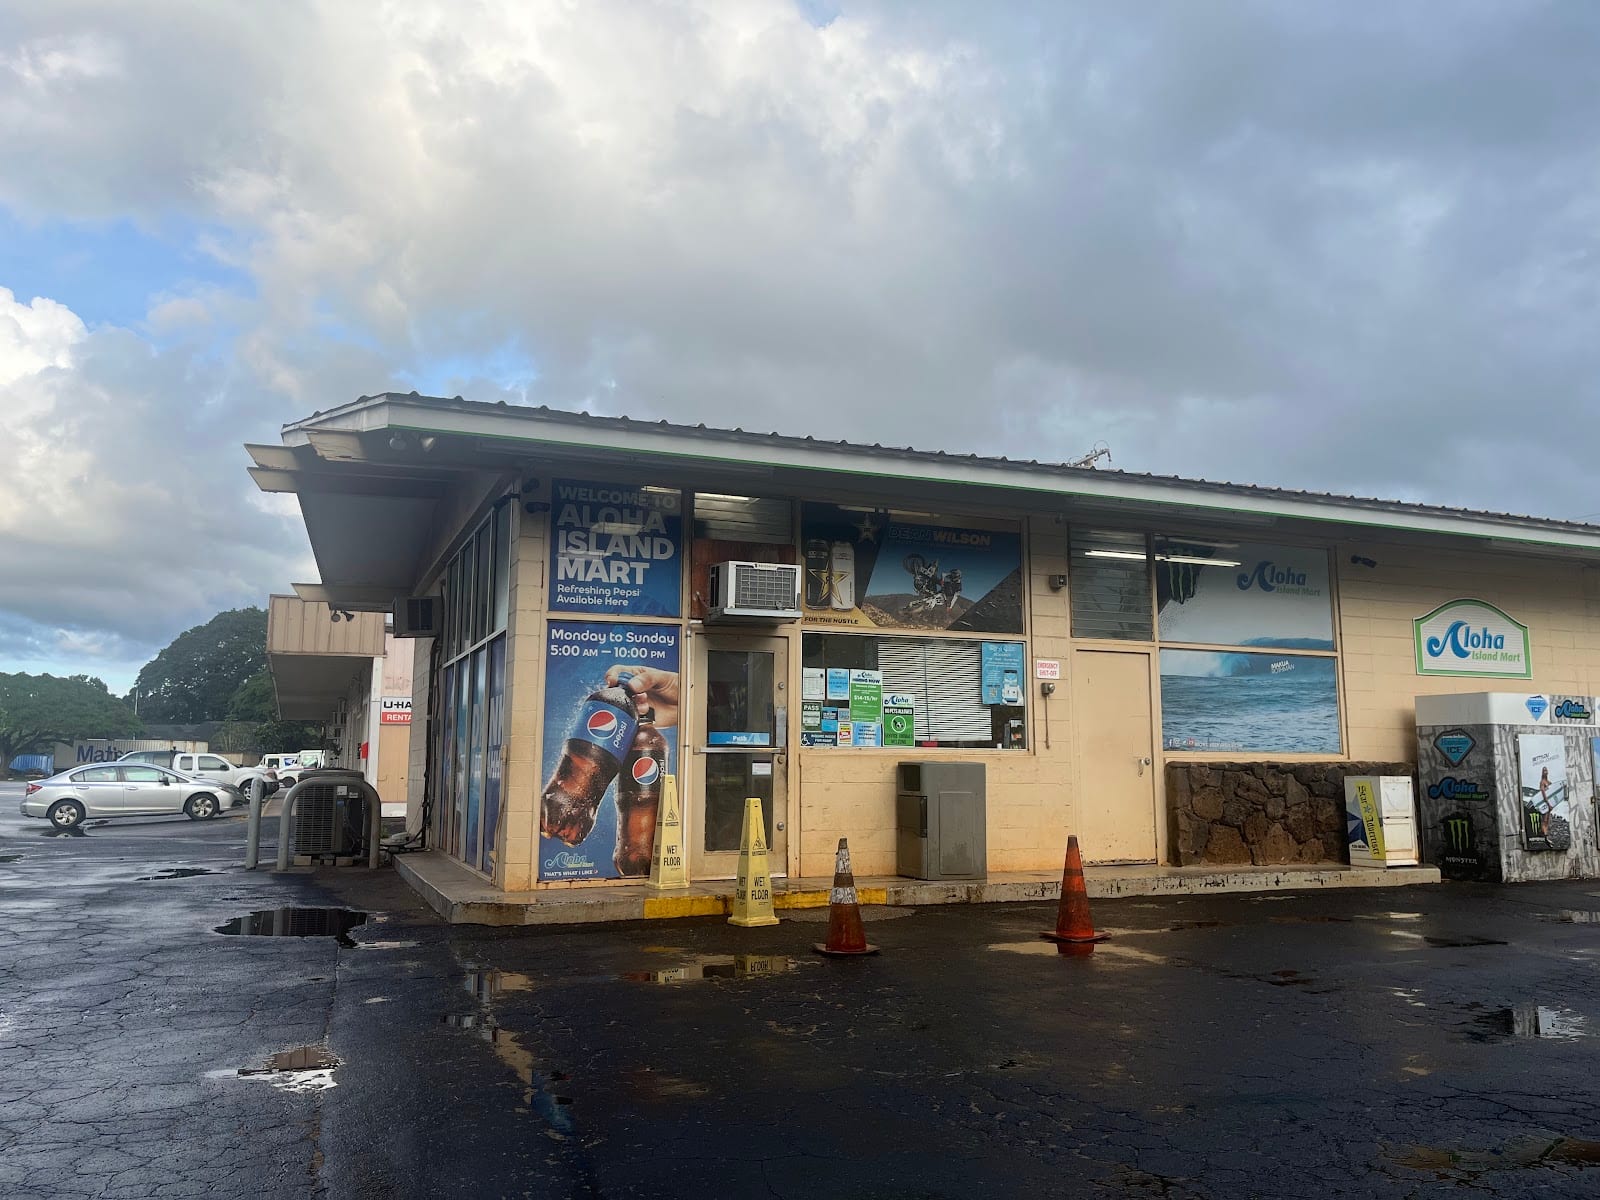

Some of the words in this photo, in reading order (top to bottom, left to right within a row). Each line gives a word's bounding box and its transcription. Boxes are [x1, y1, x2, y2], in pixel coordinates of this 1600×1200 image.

[559, 486, 648, 506] WELCOME
[652, 494, 676, 509] TO
[557, 503, 667, 534] ALOHA
[558, 529, 675, 560] ISLAND
[933, 530, 991, 546] WILSON
[557, 557, 650, 585] MART
[1236, 560, 1307, 592] Aloha
[557, 584, 611, 597] Refreshing
[613, 587, 641, 598] Pepsi
[556, 595, 603, 605] Available
[605, 597, 629, 606] Here
[551, 629, 606, 644] Monday
[609, 632, 623, 642] to
[626, 632, 675, 646] Sunday
[1426, 620, 1505, 659] Aloha
[550, 645, 580, 656] 5:00
[582, 649, 598, 657] AM
[614, 646, 648, 658] 10:00
[1472, 651, 1498, 661] Island
[1500, 653, 1521, 662] Mart
[613, 721, 628, 749] pepsi
[1446, 746, 1463, 754] ICE
[1429, 777, 1477, 799] Aloha
[666, 845, 678, 855] WET
[663, 857, 681, 866] FLOOR
[1445, 856, 1478, 865] MONSTER
[754, 877, 766, 887] WET
[751, 889, 769, 900] FLOOR
